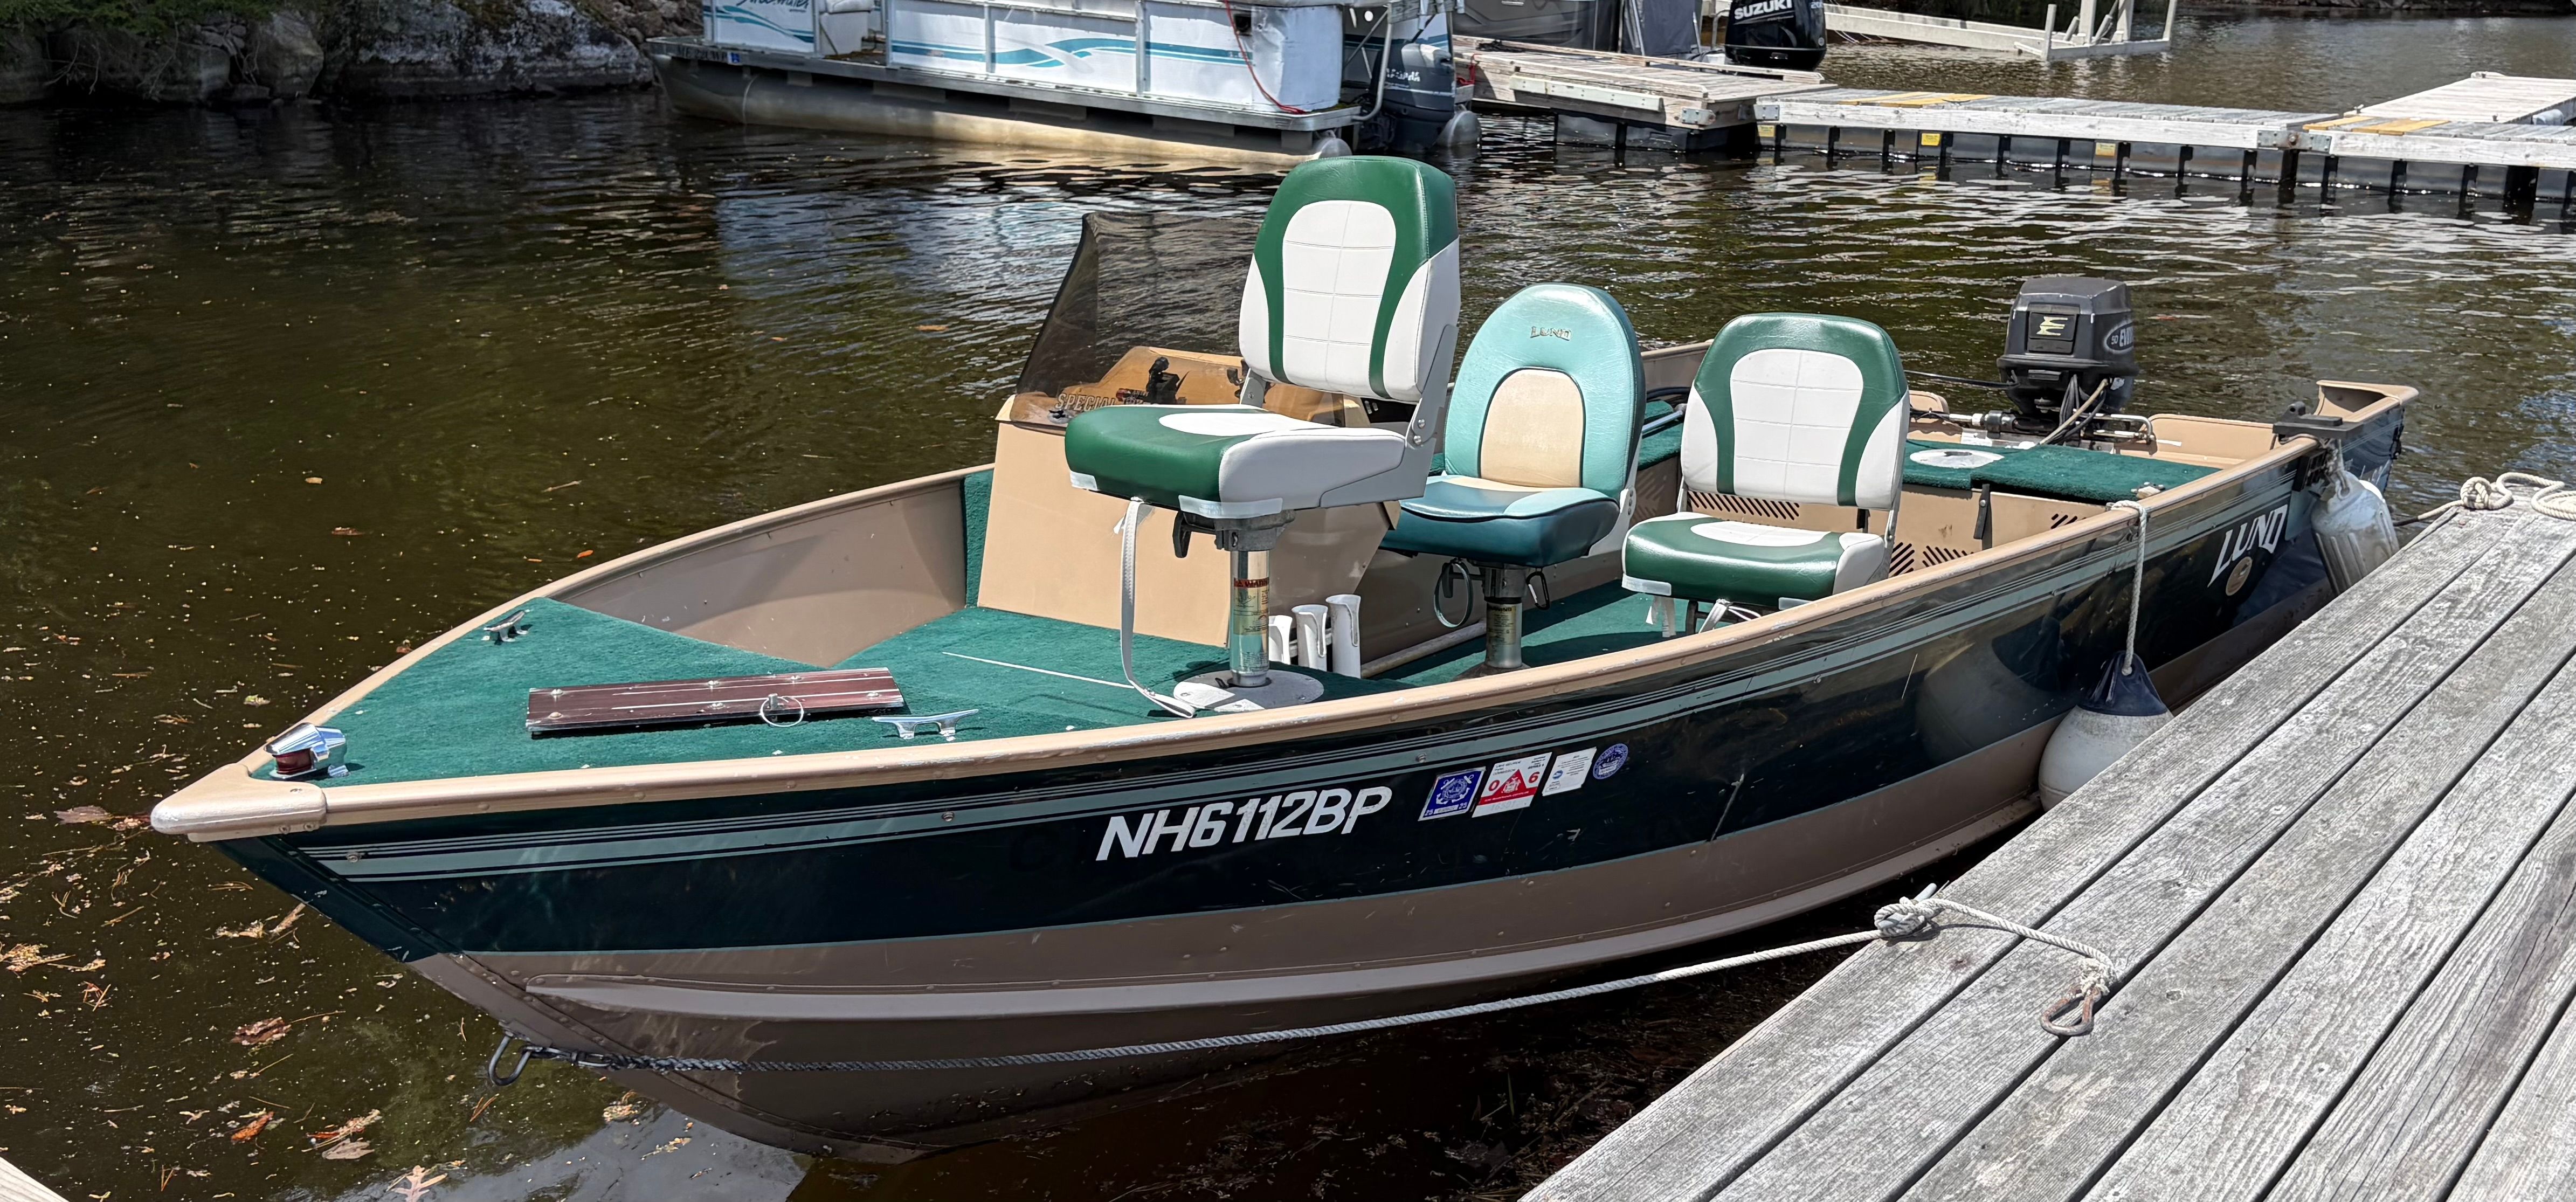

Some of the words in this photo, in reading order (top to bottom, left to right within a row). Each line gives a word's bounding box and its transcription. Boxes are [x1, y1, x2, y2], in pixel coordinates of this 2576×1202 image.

[1734, 0, 1792, 19] SUZUKI
[1530, 326, 1571, 341] LUND
[2111, 335, 2119, 345] 50
[2207, 504, 2288, 587] LUND
[1488, 779, 1500, 791] 0
[1528, 771, 1540, 783] 6
[1096, 786, 1393, 862] NH6112BP
